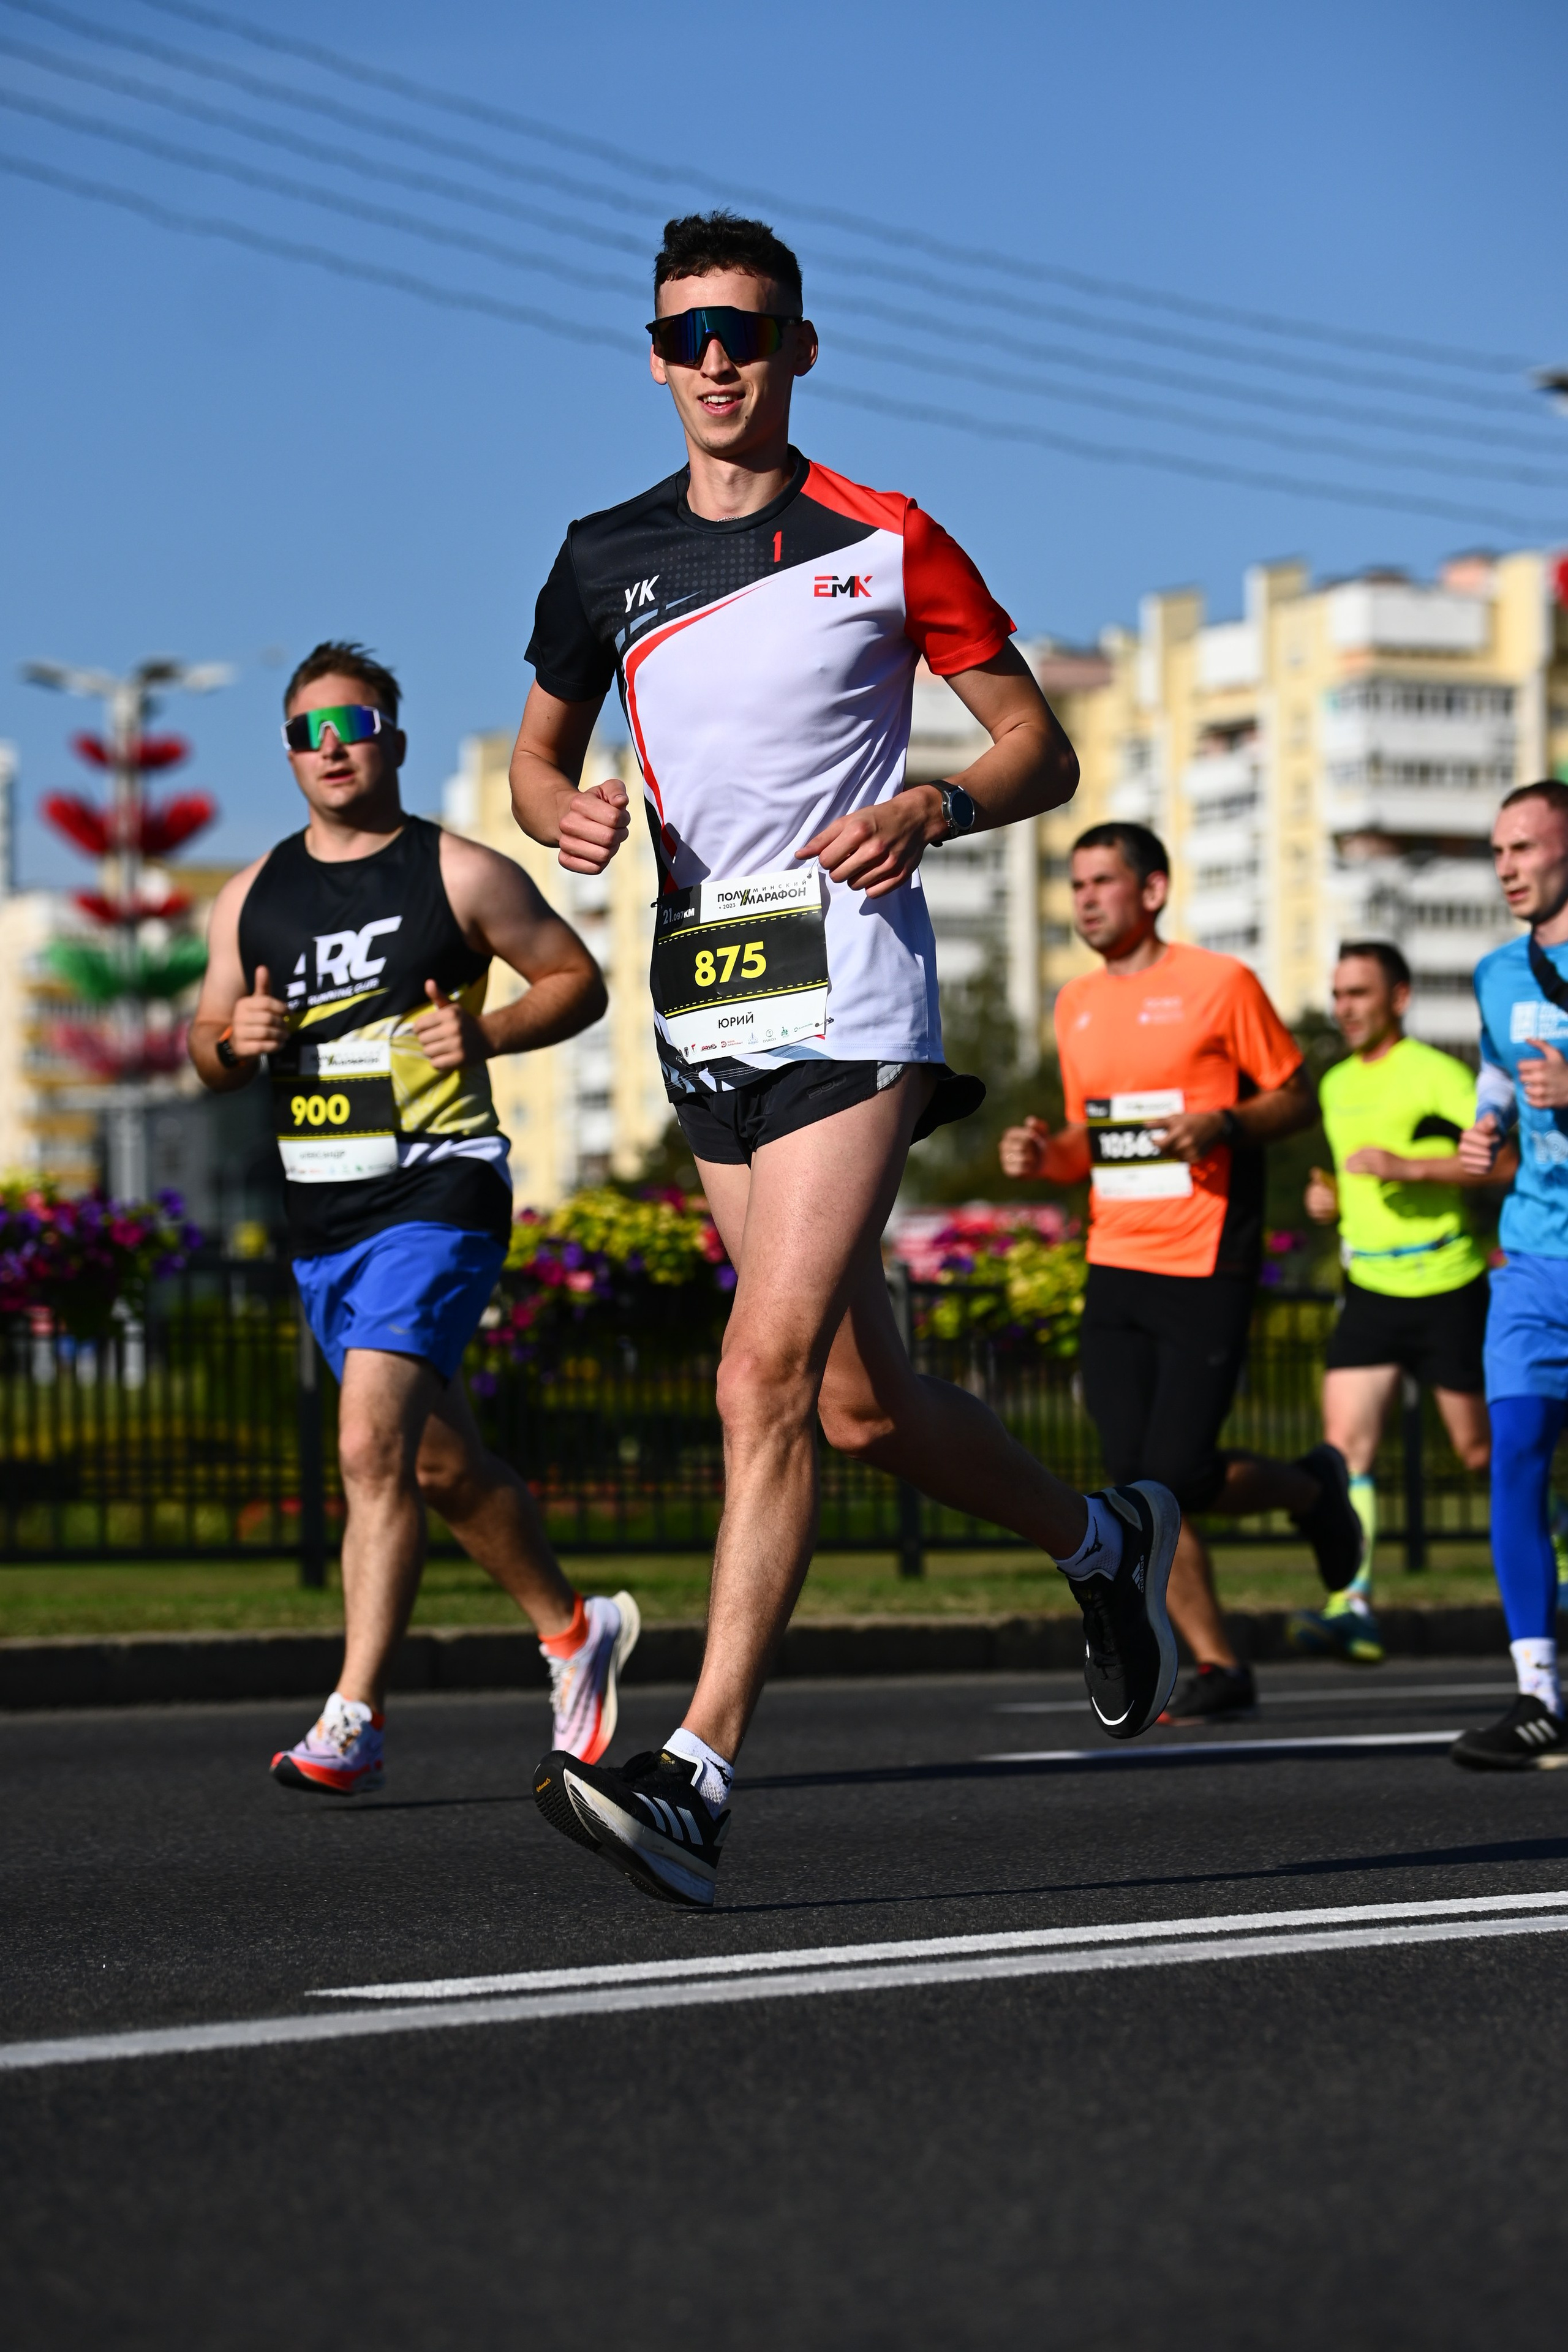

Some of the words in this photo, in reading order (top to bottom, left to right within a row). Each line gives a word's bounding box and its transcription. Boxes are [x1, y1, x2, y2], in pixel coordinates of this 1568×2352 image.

[773, 530, 782, 563] 1
[752, 880, 807, 893] МИНСКИЙ
[695, 941, 766, 987] 875
[718, 1011, 754, 1029] ЮРИЙ
[291, 1093, 350, 1126] 900
